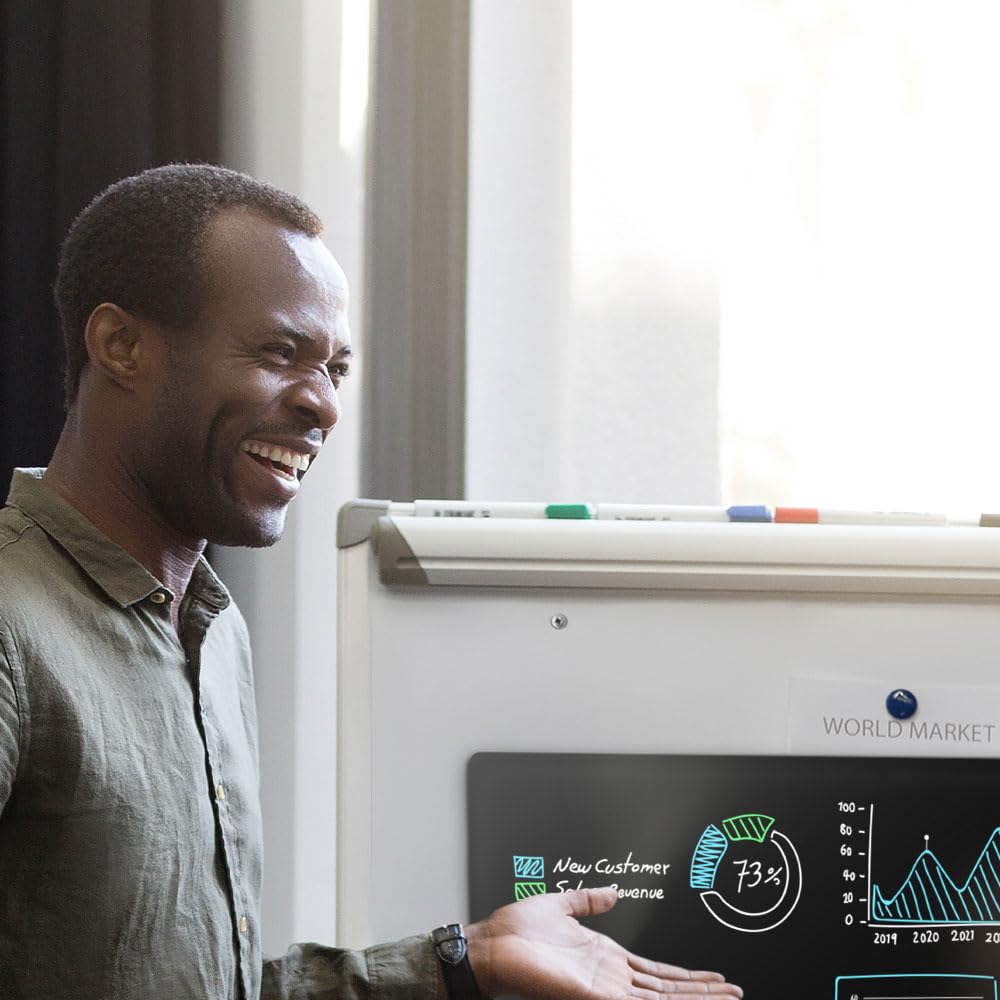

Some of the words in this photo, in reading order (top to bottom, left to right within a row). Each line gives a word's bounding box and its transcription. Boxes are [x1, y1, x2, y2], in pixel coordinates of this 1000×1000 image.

[823, 716, 903, 739] WORLD
[909, 721, 996, 742] MARKET
[837, 801, 856, 814] 100
[839, 823, 853, 837] 80
[840, 843, 853, 857] 60
[552, 856, 592, 874] New
[595, 851, 671, 876] Customer
[733, 860, 783, 893] 73%
[842, 869, 856, 883] 40
[842, 891, 855, 905] 20
[844, 912, 854, 926] 0
[873, 932, 898, 946] 2019
[912, 930, 940, 944] 2020
[950, 929, 975, 942] 2021
